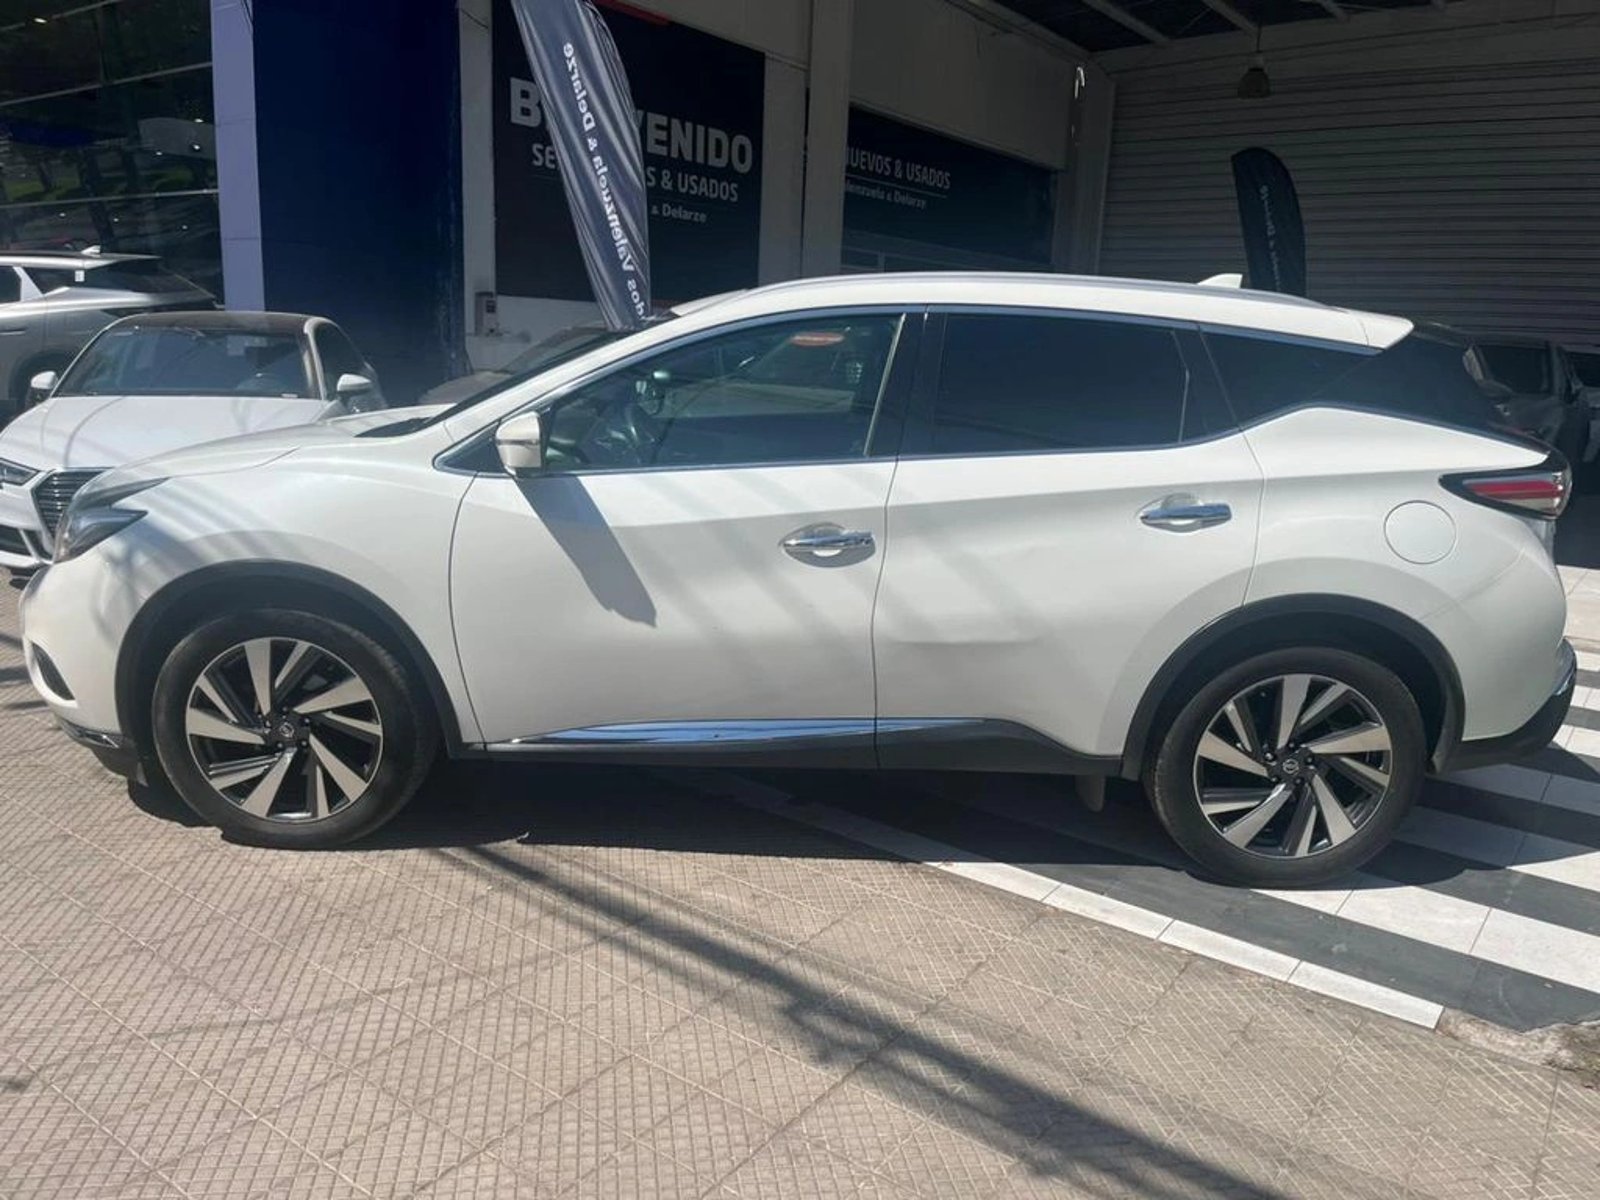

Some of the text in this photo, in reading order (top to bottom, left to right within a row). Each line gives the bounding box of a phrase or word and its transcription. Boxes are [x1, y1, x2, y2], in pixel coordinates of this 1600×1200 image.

[509, 77, 754, 174] BENIDO
[661, 169, 738, 202] & USADOS
[894, 159, 903, 180] &
[906, 162, 951, 190] USADOS
[662, 203, 708, 223] Delarze
